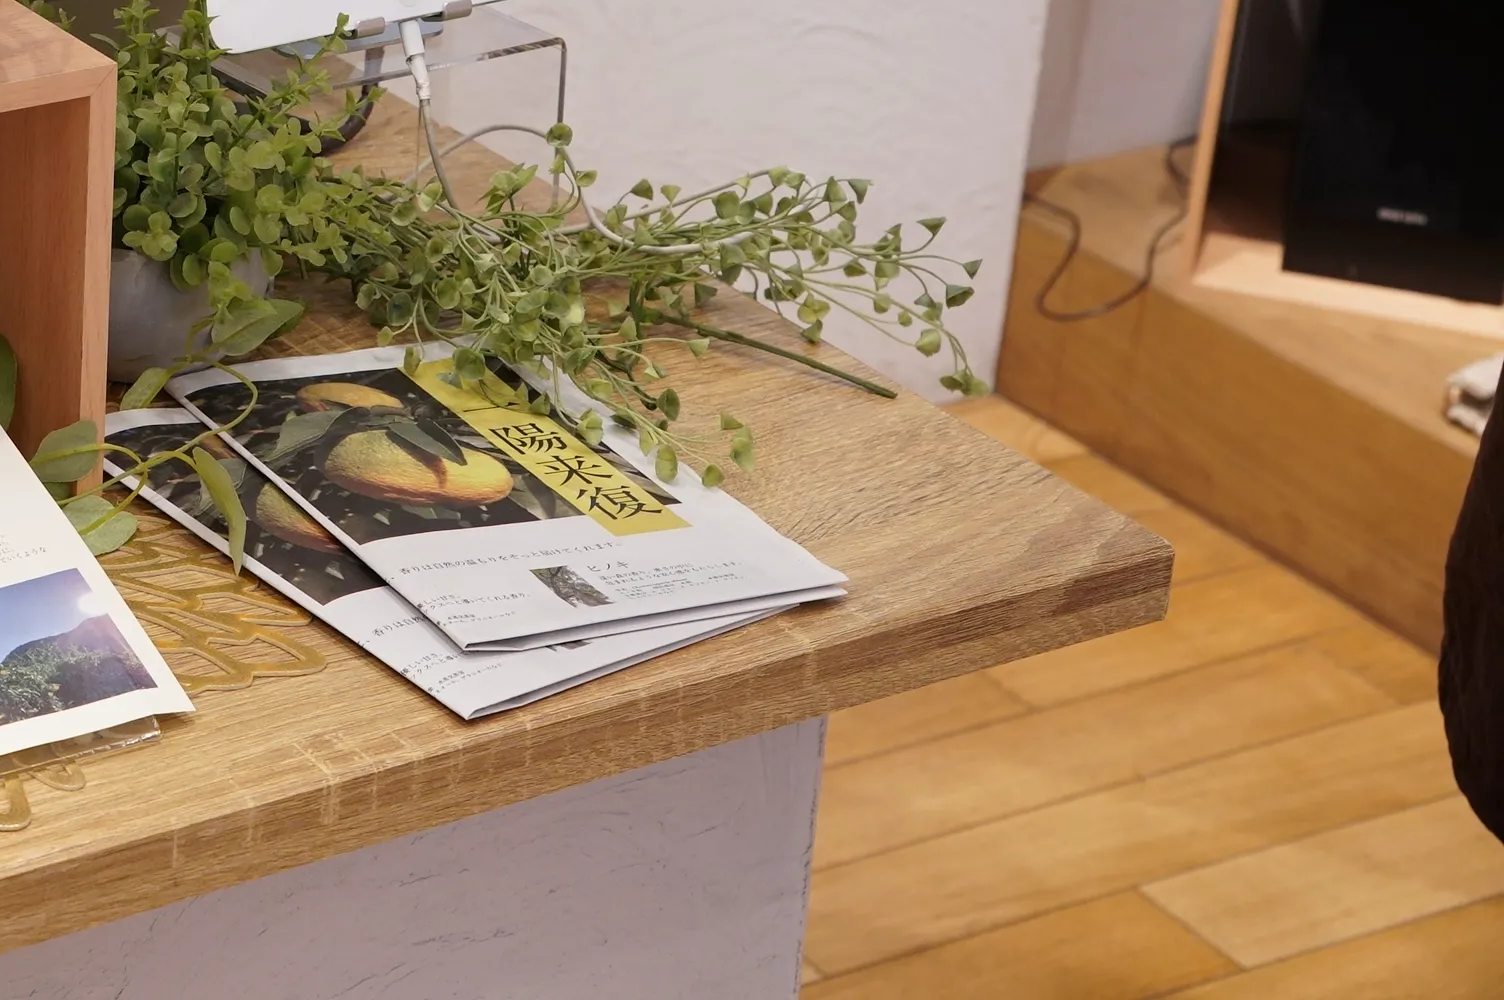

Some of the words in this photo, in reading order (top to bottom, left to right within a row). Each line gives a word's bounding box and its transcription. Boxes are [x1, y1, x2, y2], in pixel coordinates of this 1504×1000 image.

[463, 402, 663, 520] 一陽来復
[587, 560, 629, 572] ヒノキ
